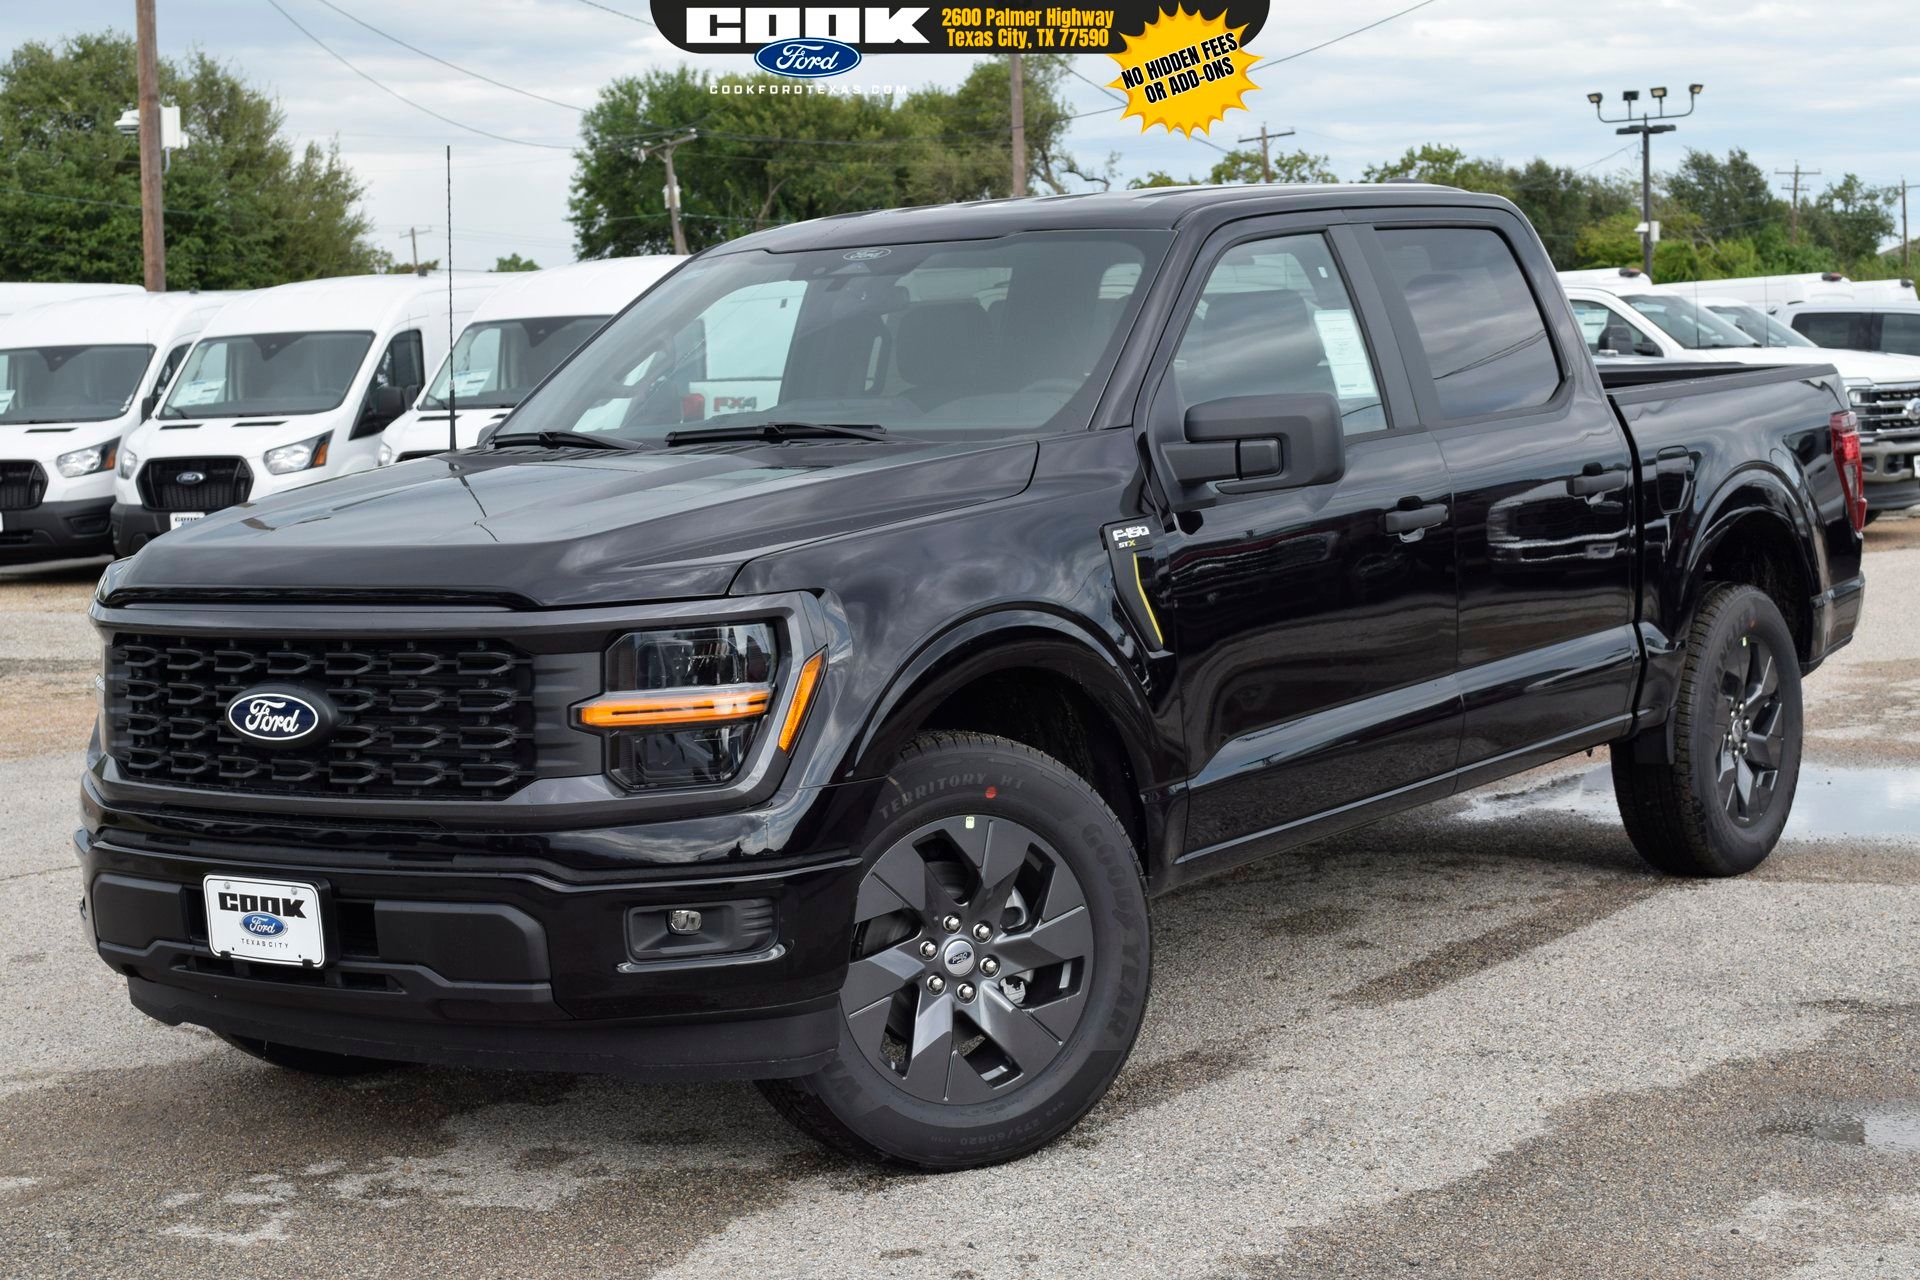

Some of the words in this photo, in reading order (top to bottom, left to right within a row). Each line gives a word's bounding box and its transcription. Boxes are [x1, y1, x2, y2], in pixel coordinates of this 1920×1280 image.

[713, 396, 758, 412] FX4
[1112, 525, 1150, 541] F-150
[1118, 539, 1136, 549] STX
[245, 699, 300, 733] Ford
[880, 772, 987, 820] TERRITORY
[999, 774, 1026, 790] HT
[218, 891, 307, 919] COOK
[249, 916, 276, 934] Ford
